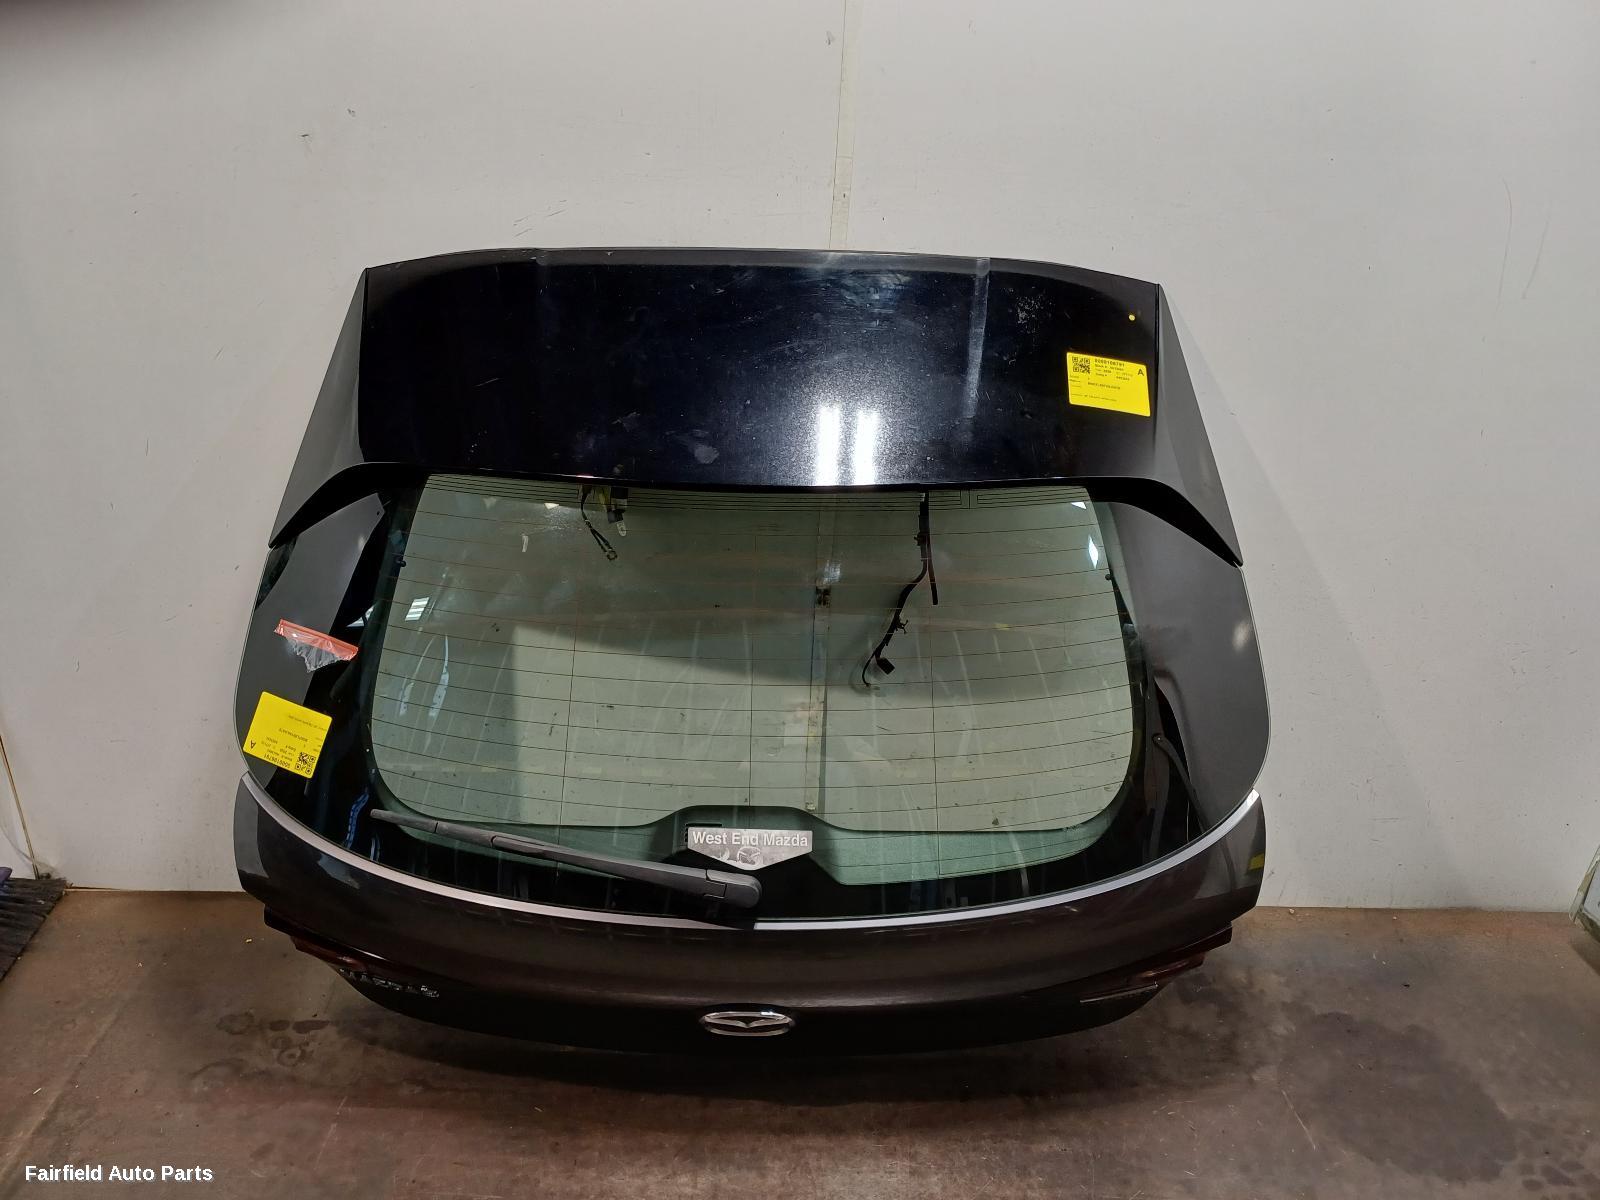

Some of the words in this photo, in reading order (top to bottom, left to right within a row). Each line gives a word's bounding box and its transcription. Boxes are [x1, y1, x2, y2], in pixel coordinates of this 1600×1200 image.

[1137, 368, 1145, 376] A
[250, 740, 256, 749] A
[692, 831, 727, 844] West
[732, 832, 759, 846] End
[764, 833, 808, 847] Mazda
